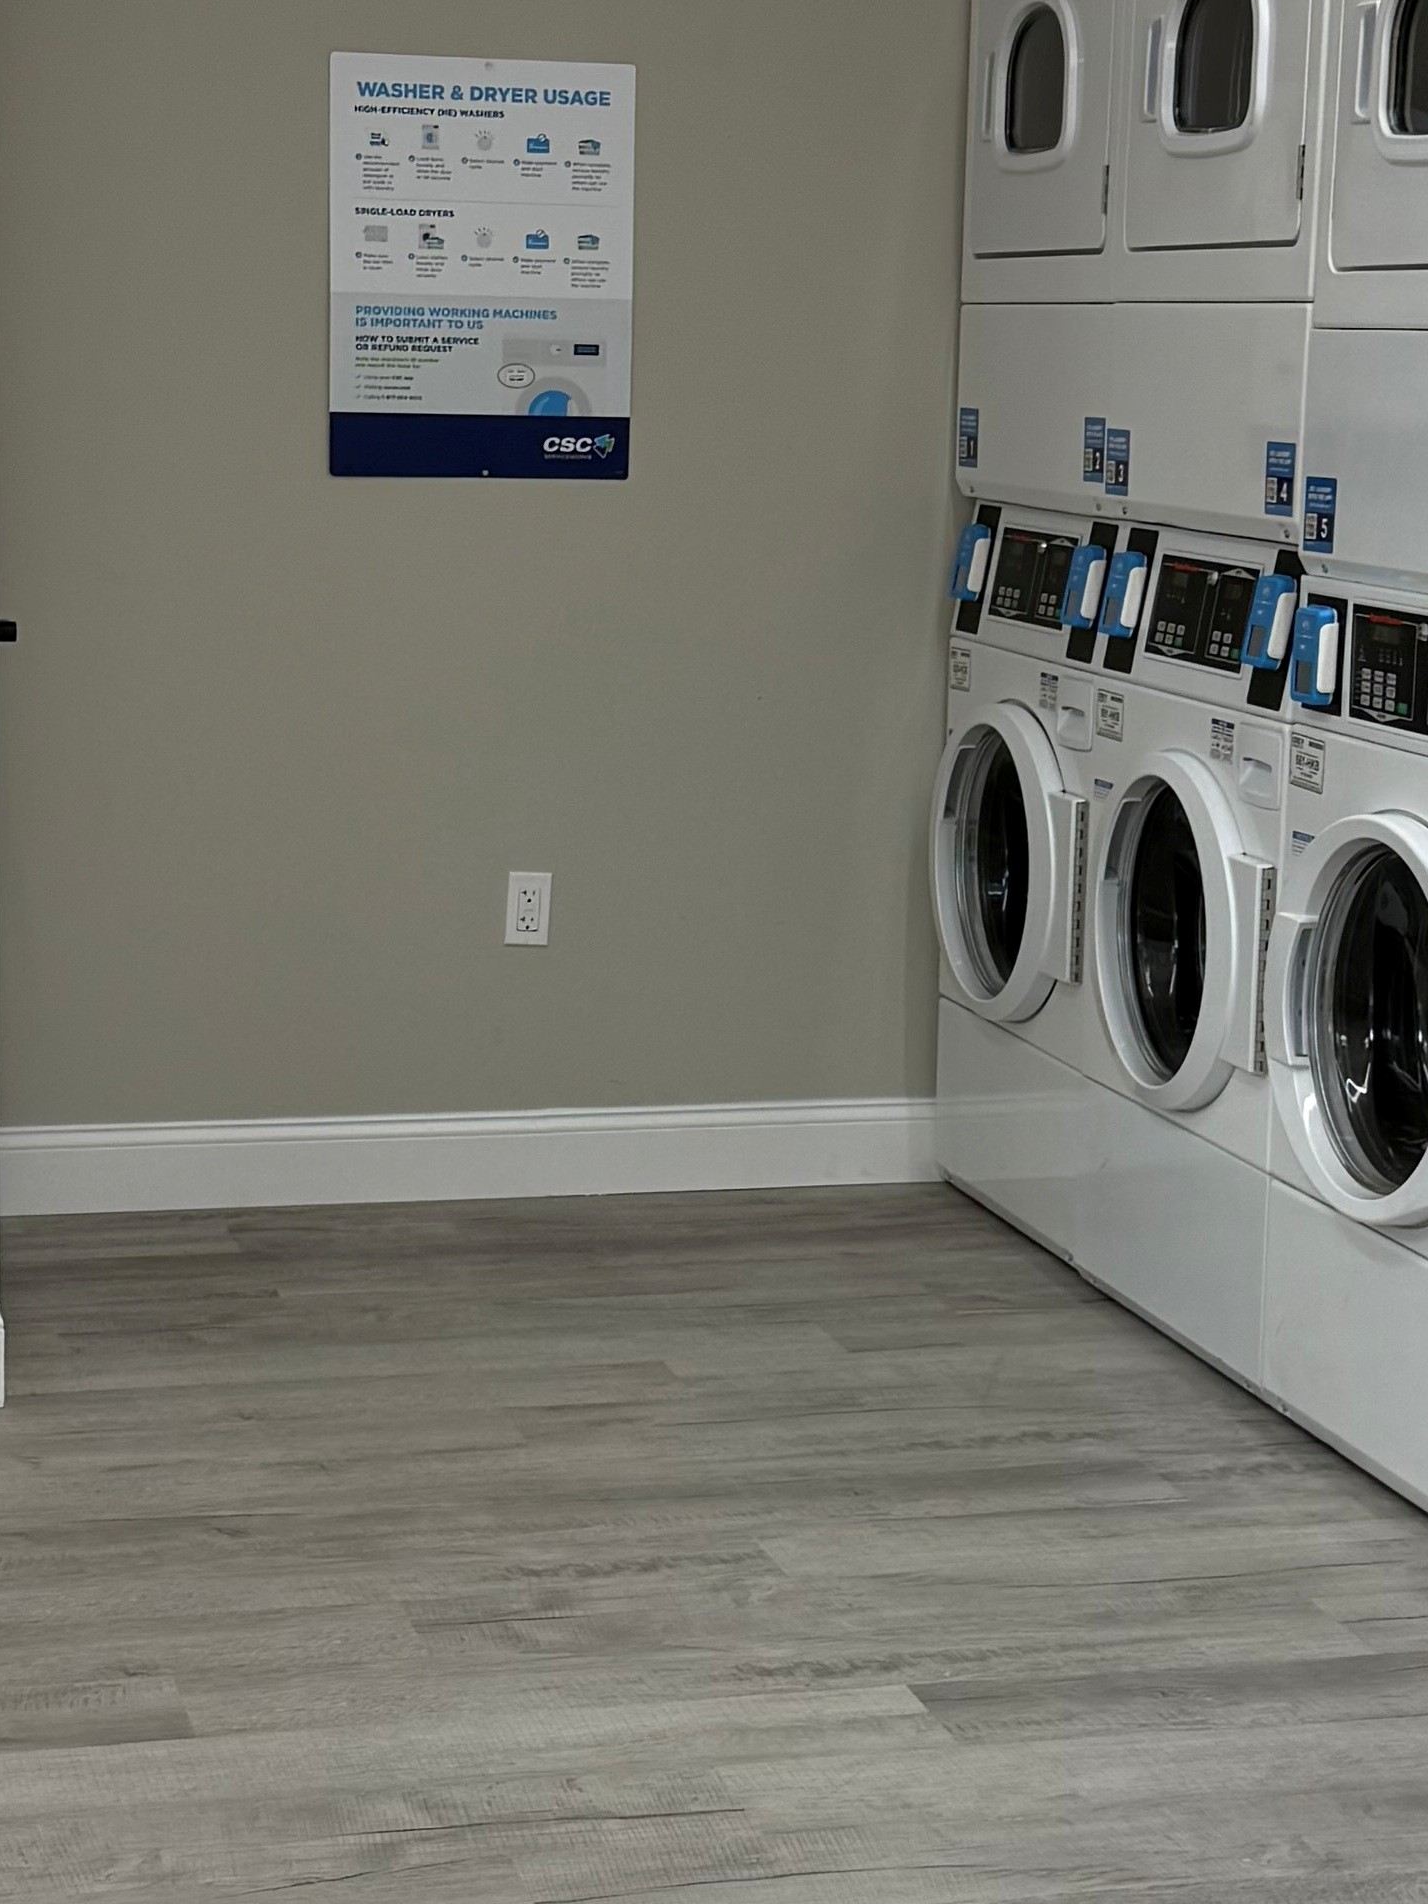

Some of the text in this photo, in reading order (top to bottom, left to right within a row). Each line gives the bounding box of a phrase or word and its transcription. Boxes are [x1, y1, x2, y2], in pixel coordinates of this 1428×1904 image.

[356, 81, 612, 107] WASHER & DRYER USAGE
[459, 108, 505, 119] WASHERS
[355, 305, 558, 320] PROVIDING WORKING MACHINES
[355, 316, 485, 330] IS IMPORTANT TO US
[380, 335, 395, 344] TO
[431, 336, 439, 345] A
[441, 336, 480, 346] SERVICE
[411, 343, 453, 353] REQUEST
[542, 436, 593, 453] CSC
[1280, 481, 1288, 502] 4
[1320, 518, 1328, 538] 5
